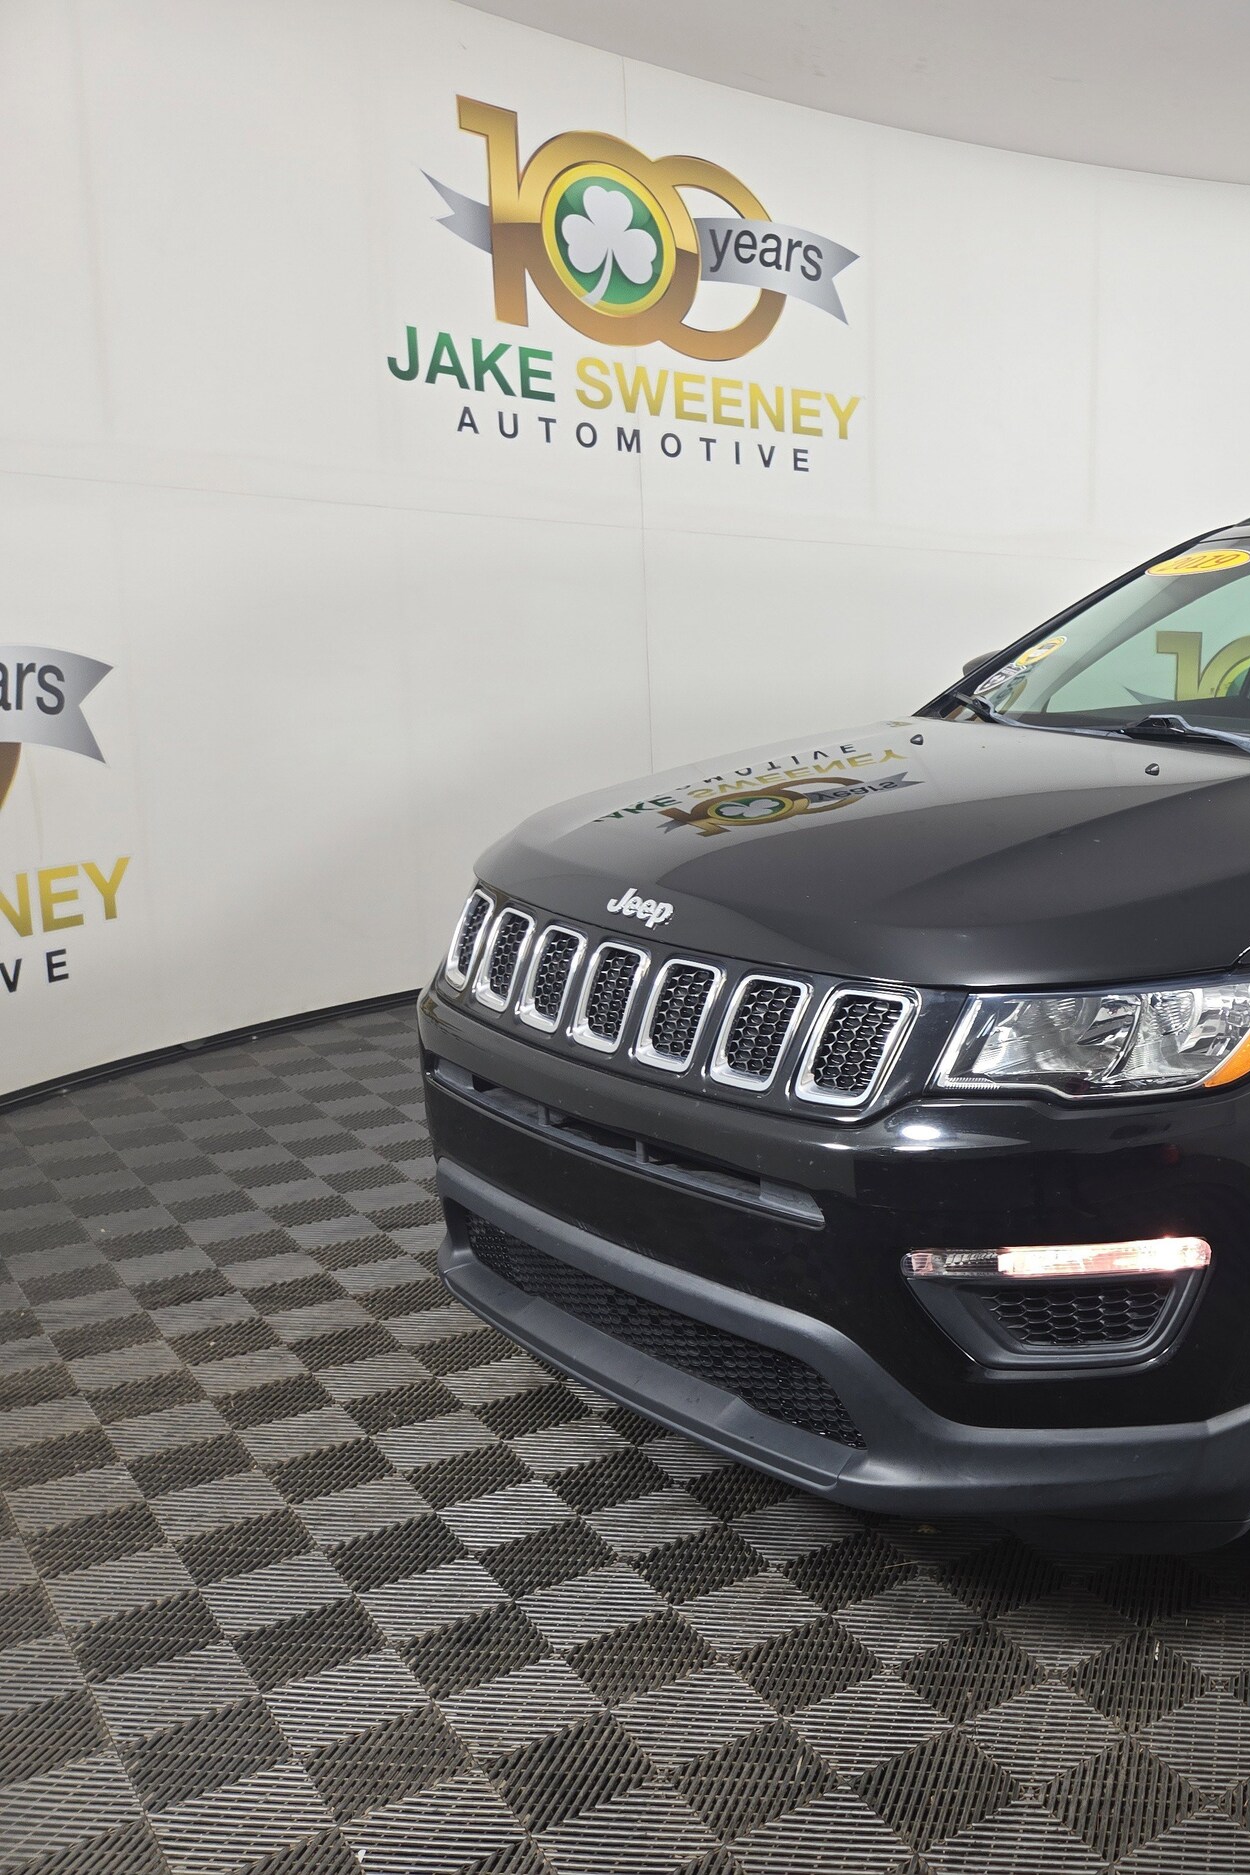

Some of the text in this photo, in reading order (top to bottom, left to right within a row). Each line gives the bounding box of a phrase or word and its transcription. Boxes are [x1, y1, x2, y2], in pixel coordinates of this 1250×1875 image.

[456, 94, 787, 361] 100
[709, 228, 823, 281] years
[386, 325, 860, 439] JAKE SWEENEY
[457, 406, 810, 473] AUTOMOTIVE
[1156, 553, 1241, 572] 2019
[607, 888, 674, 930] Jeep
